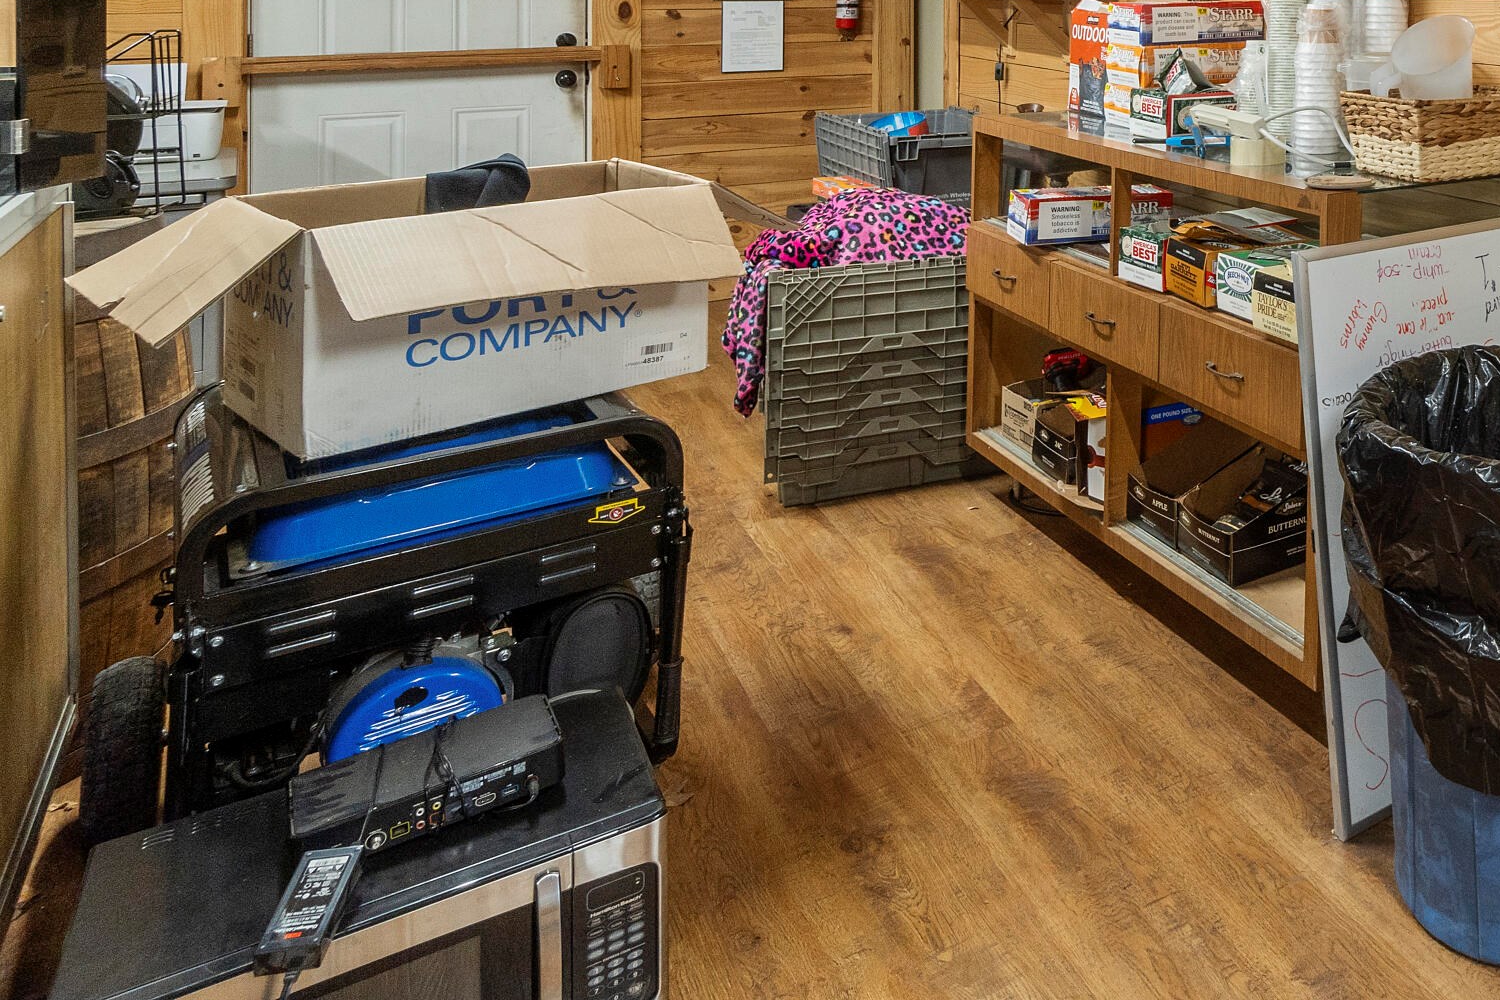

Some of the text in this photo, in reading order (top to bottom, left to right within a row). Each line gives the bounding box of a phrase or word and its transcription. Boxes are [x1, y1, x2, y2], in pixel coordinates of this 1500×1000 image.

[1209, 7, 1255, 22] STARR
[1141, 103, 1162, 115] BEST
[1133, 246, 1157, 262] BEST
[1257, 303, 1278, 319] PRIDE
[405, 301, 638, 368] COMPANY
[1163, 410, 1180, 418] POUND
[1152, 499, 1168, 512] APPLE
[620, 894, 643, 905] Beach
